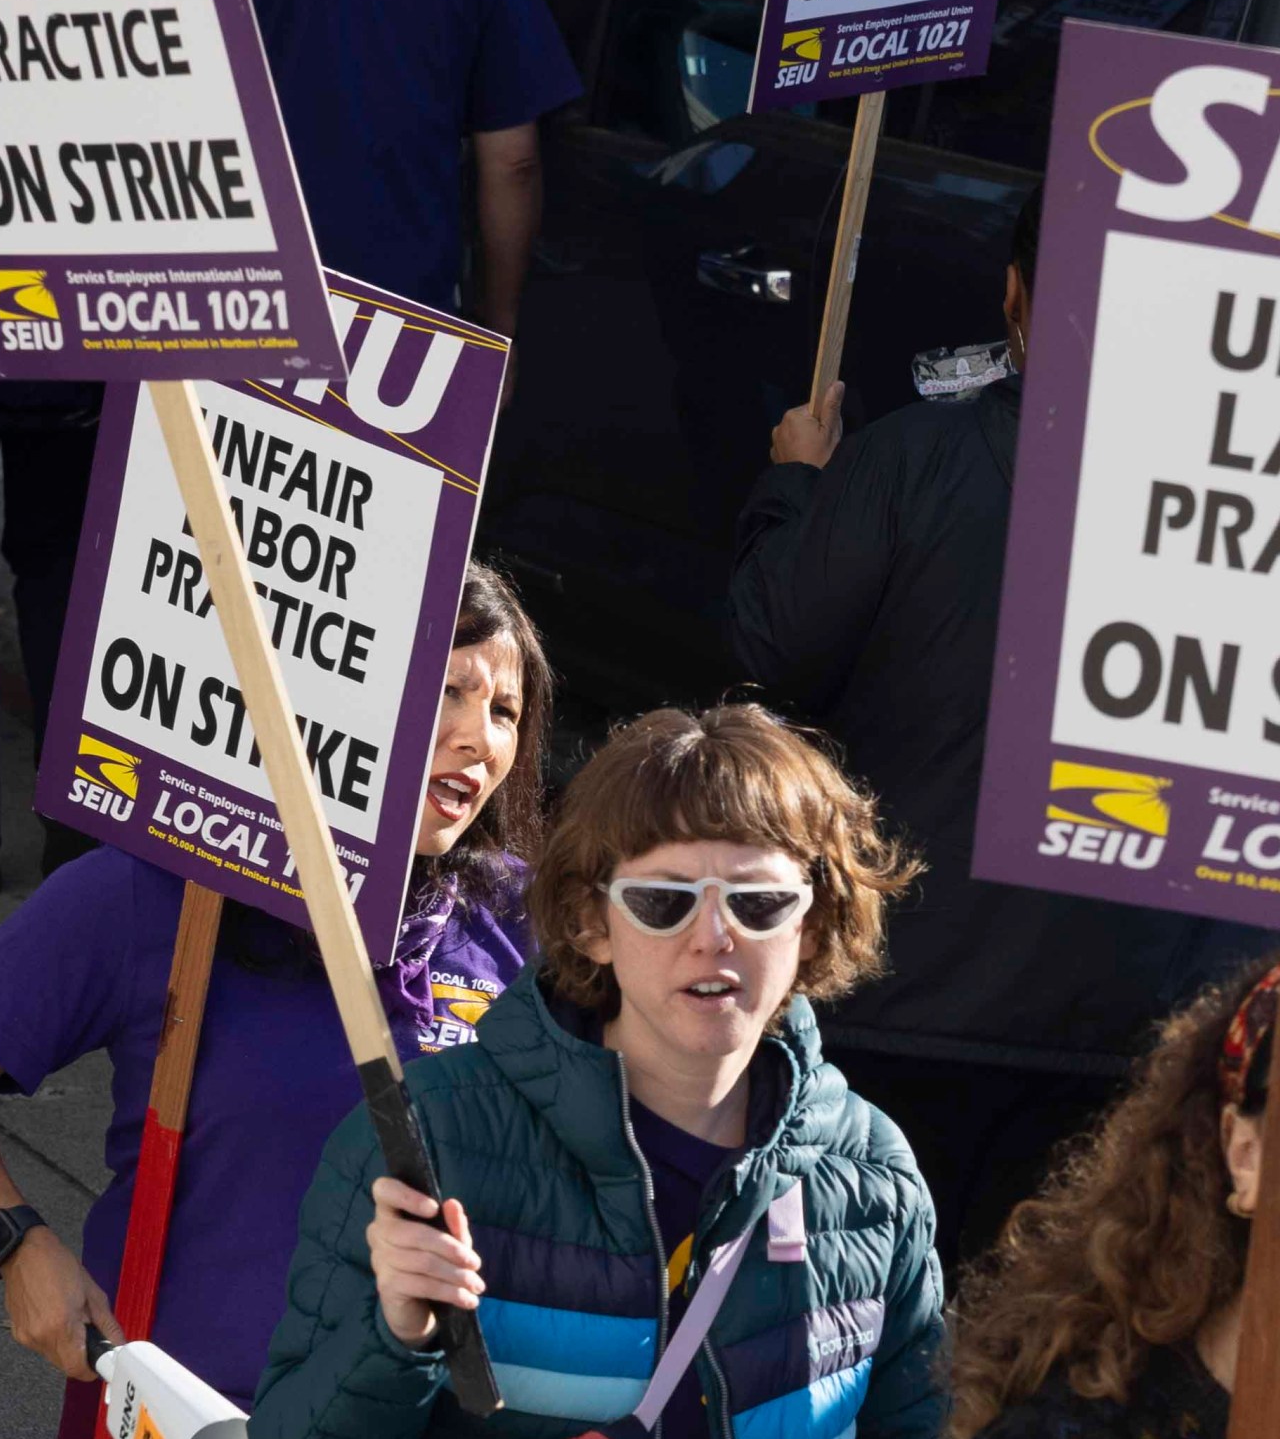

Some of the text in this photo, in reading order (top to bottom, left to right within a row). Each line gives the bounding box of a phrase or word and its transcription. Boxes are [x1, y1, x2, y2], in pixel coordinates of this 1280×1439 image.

[832, 19, 968, 65] LOCAL 1021
[774, 62, 819, 86] SEIU
[60, 139, 252, 224] STRIKE
[66, 268, 279, 286] Service Employees International Union
[78, 290, 286, 331] LOCAL 1021
[0, 321, 62, 348] SEIU
[100, 637, 186, 729] ON
[1079, 621, 1240, 733] ON
[68, 778, 133, 820] SEIU
[159, 769, 255, 819] Service Employees
[1209, 789, 1279, 813] Service
[153, 790, 267, 866] LOCAL
[1039, 821, 1163, 867] SEIU
[471, 978, 497, 993] 1021
